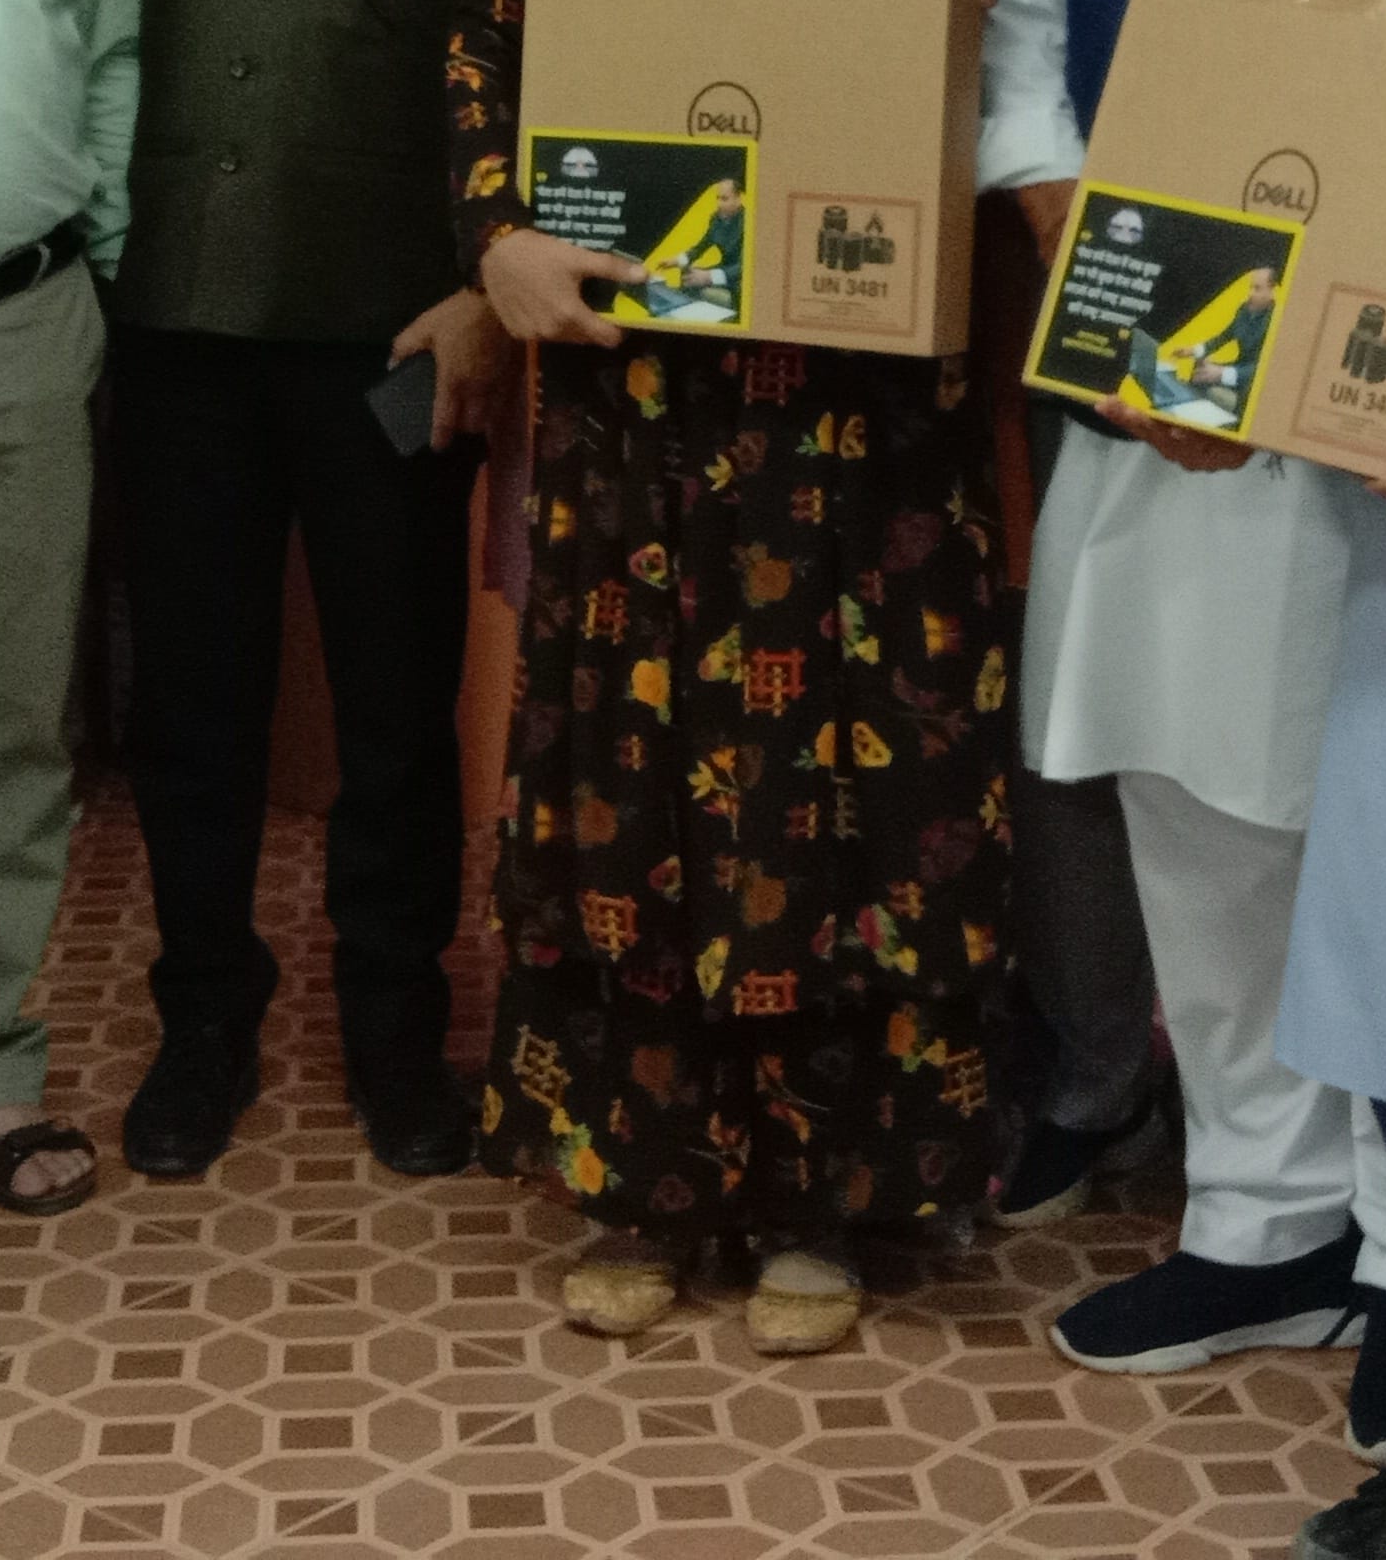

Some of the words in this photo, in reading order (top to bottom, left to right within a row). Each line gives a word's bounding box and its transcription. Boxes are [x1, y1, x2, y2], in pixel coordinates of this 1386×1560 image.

[697, 111, 752, 134] DELL
[1253, 181, 1309, 213] DELL
[811, 275, 841, 295] UN
[844, 278, 889, 298] 3481
[1329, 381, 1360, 407] UN
